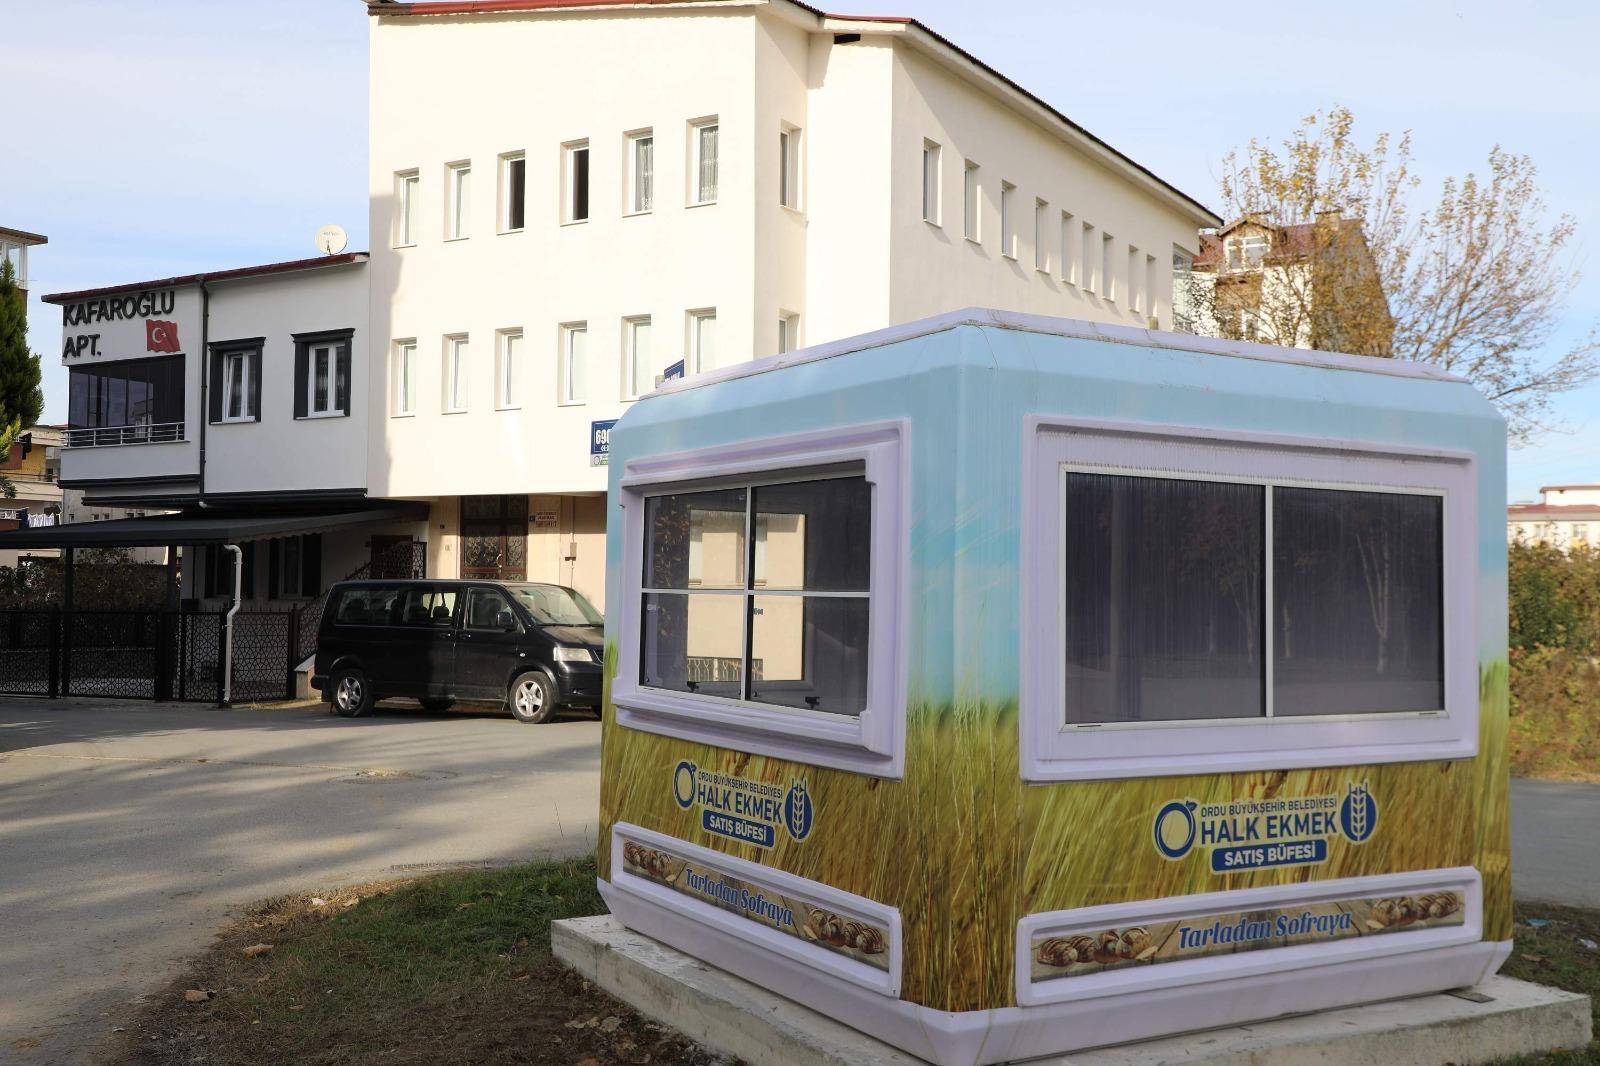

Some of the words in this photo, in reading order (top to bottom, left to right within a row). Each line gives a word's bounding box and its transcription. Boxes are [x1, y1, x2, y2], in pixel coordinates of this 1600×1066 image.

[63, 290, 175, 326] KAFAROĞLU
[63, 334, 101, 358] APT.
[713, 773, 749, 790] BÜYÜKŞEHİR
[750, 782, 783, 799] BELEDİYESİ
[698, 783, 731, 811] HALK
[735, 792, 782, 824] EKMEK
[1201, 806, 1226, 818] ORDU
[1229, 799, 1286, 816] BÜYÜKŞEHİR
[1289, 795, 1337, 811] BELEDİYESİ
[709, 815, 733, 834] SATIŞ
[735, 820, 767, 842] BÜFESİ
[1201, 817, 1260, 845] HALK
[1266, 811, 1338, 839] EKMEK
[1224, 848, 1265, 866] SATIŞ
[1268, 840, 1316, 862] BÜFESİ
[686, 869, 739, 906] Tarladan
[740, 889, 792, 927] Sofraya
[1178, 919, 1272, 949] Tarladan
[1276, 912, 1351, 937] Sofraya
